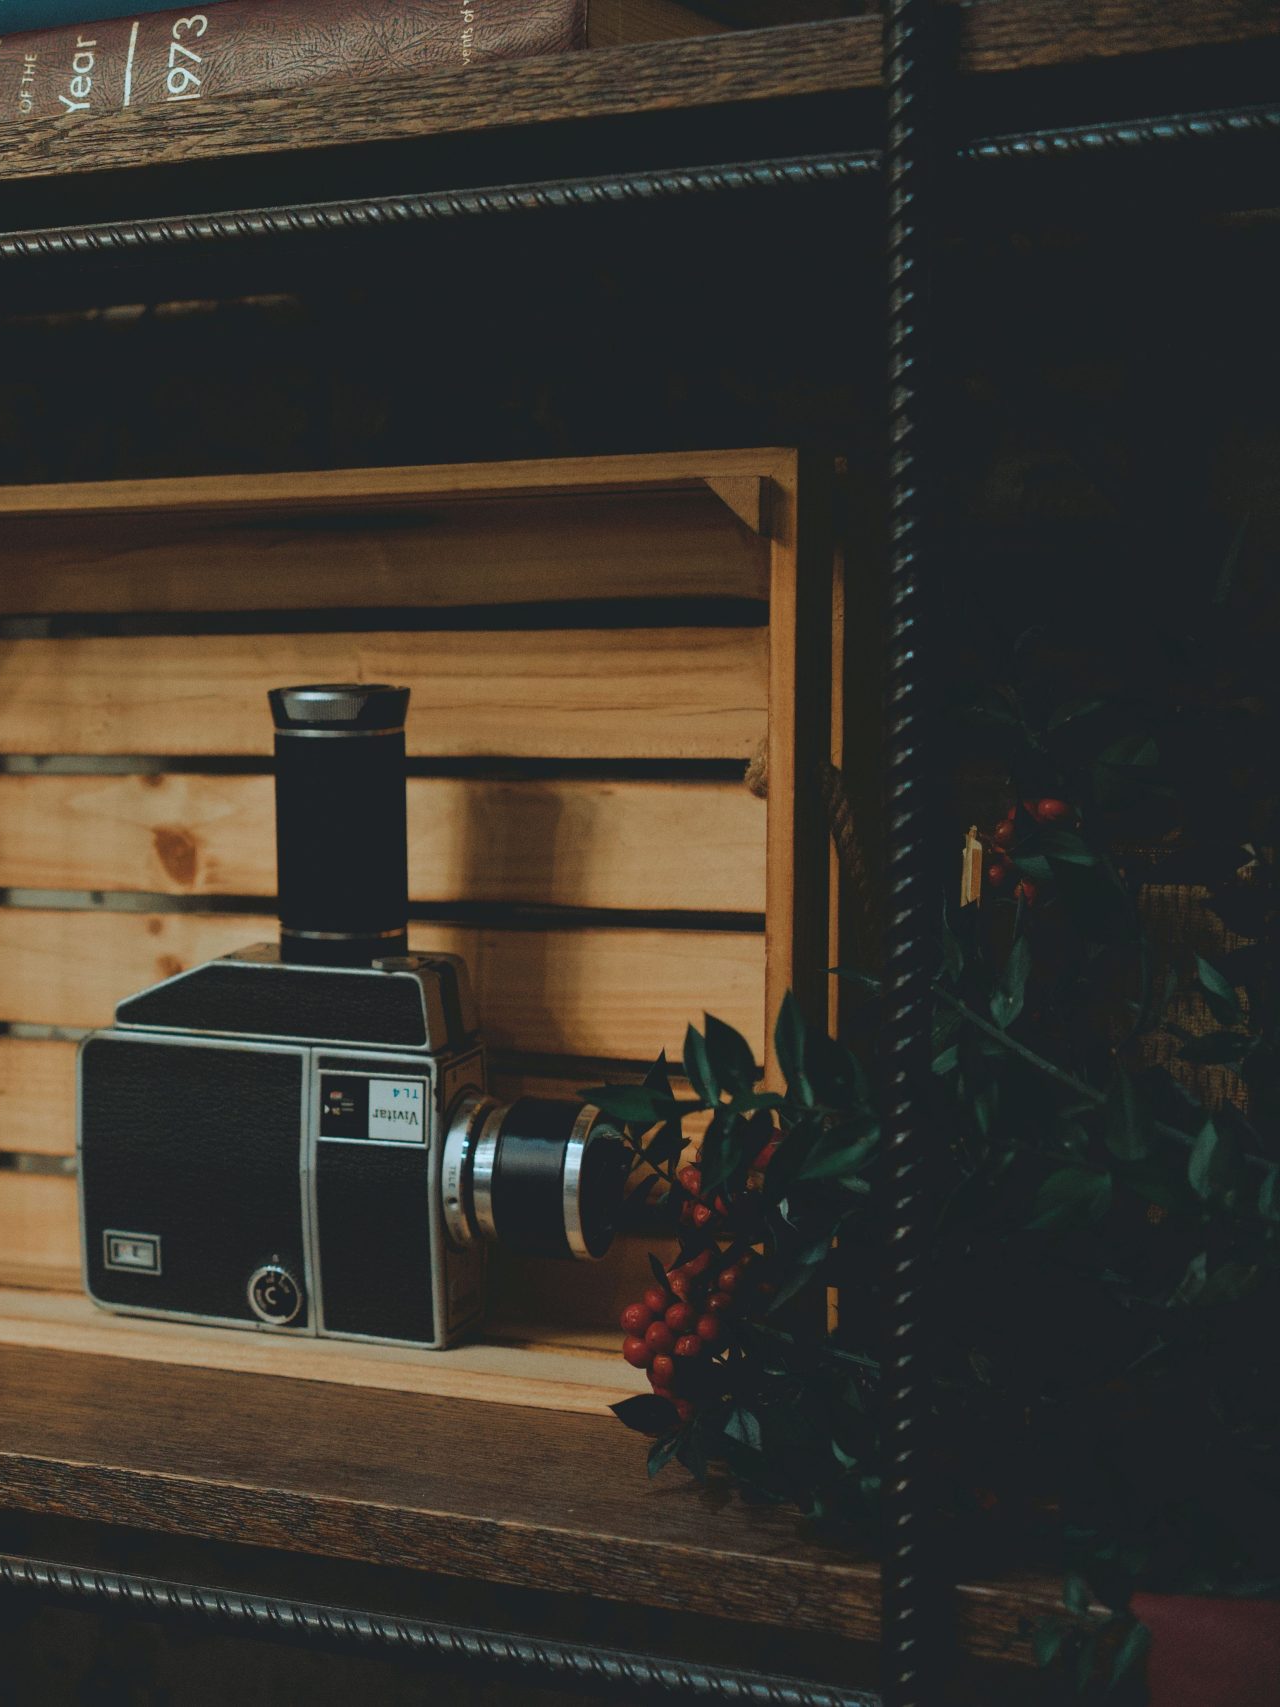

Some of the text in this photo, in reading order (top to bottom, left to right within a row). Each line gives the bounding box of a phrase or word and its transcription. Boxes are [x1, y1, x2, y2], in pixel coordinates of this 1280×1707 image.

[461, 9, 475, 23] of
[166, 14, 209, 102] 1973
[460, 27, 474, 65] vents
[18, 53, 38, 115] OF THE
[58, 35, 97, 114] Year
[373, 1109, 419, 1126] Vivitar
[448, 1166, 457, 1188] TELE
